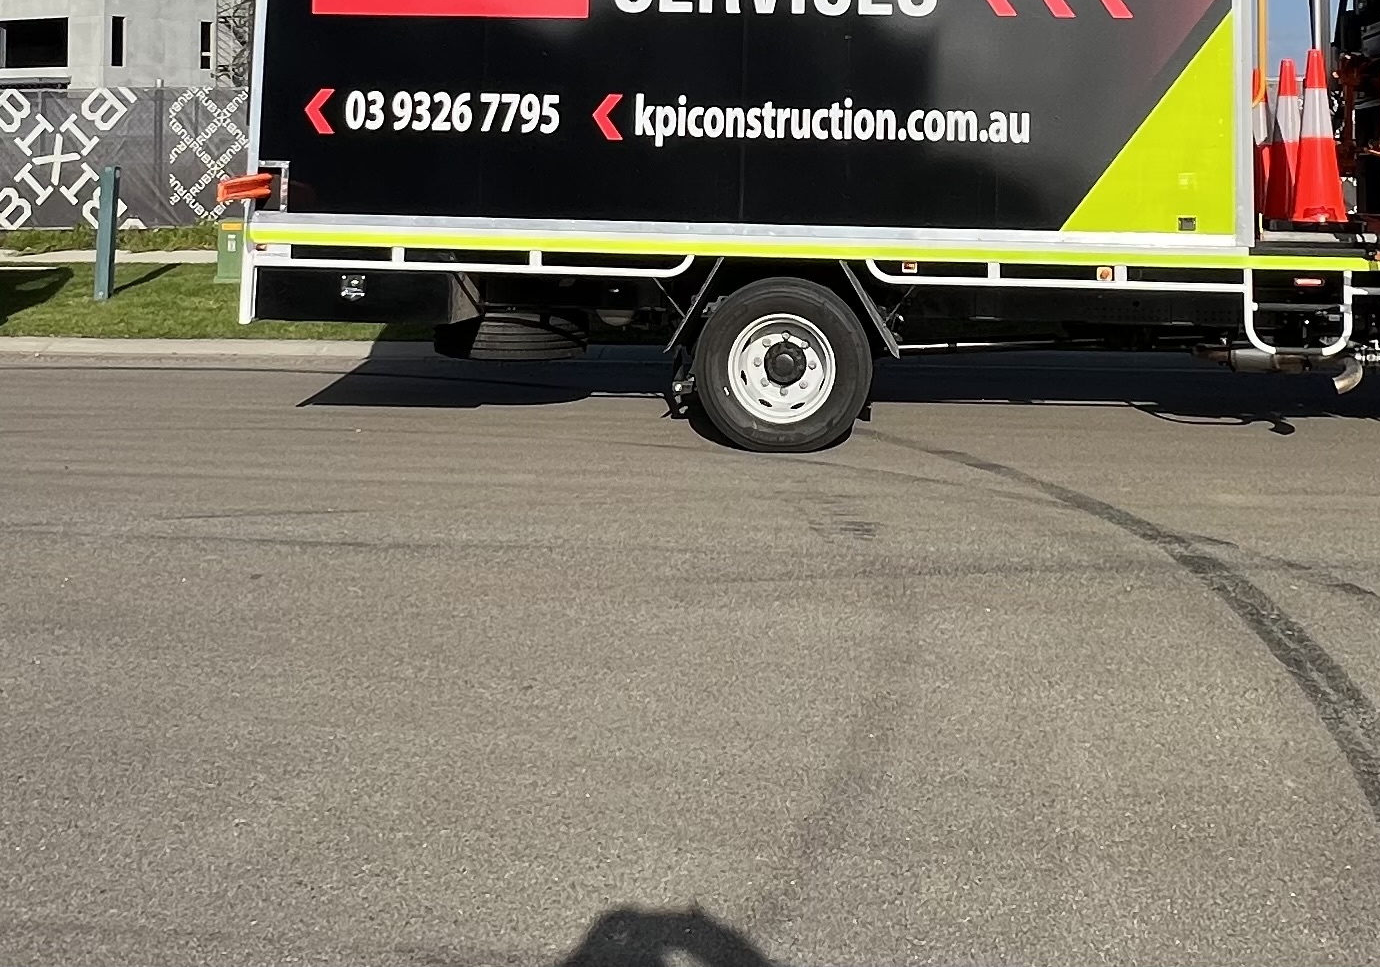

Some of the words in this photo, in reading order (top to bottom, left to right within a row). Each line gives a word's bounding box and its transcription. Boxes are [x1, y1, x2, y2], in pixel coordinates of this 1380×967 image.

[345, 90, 385, 131] 03
[391, 90, 473, 133] 9326
[480, 92, 561, 135] 7795
[633, 91, 1031, 148] kpiconstruction.com.au
